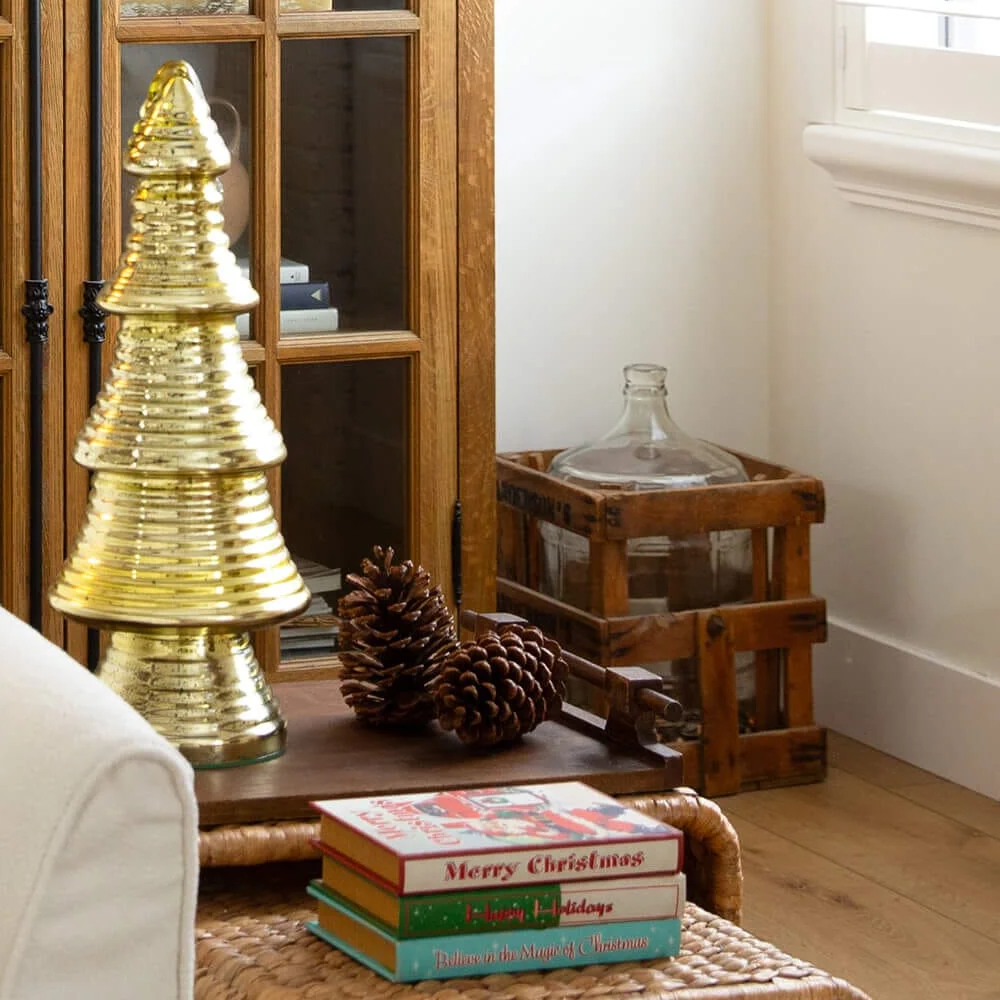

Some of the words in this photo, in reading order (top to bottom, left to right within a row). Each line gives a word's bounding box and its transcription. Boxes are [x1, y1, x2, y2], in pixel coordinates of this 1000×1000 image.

[444, 859, 519, 885] Merry
[527, 849, 646, 877] Christmas
[465, 901, 525, 923] Happy
[533, 897, 614, 921] Holidays
[433, 950, 482, 970] Believe
[484, 948, 497, 965] in
[499, 946, 517, 962] the
[520, 942, 560, 965] Magic
[562, 939, 575, 960] of
[578, 934, 648, 957] Christmas
